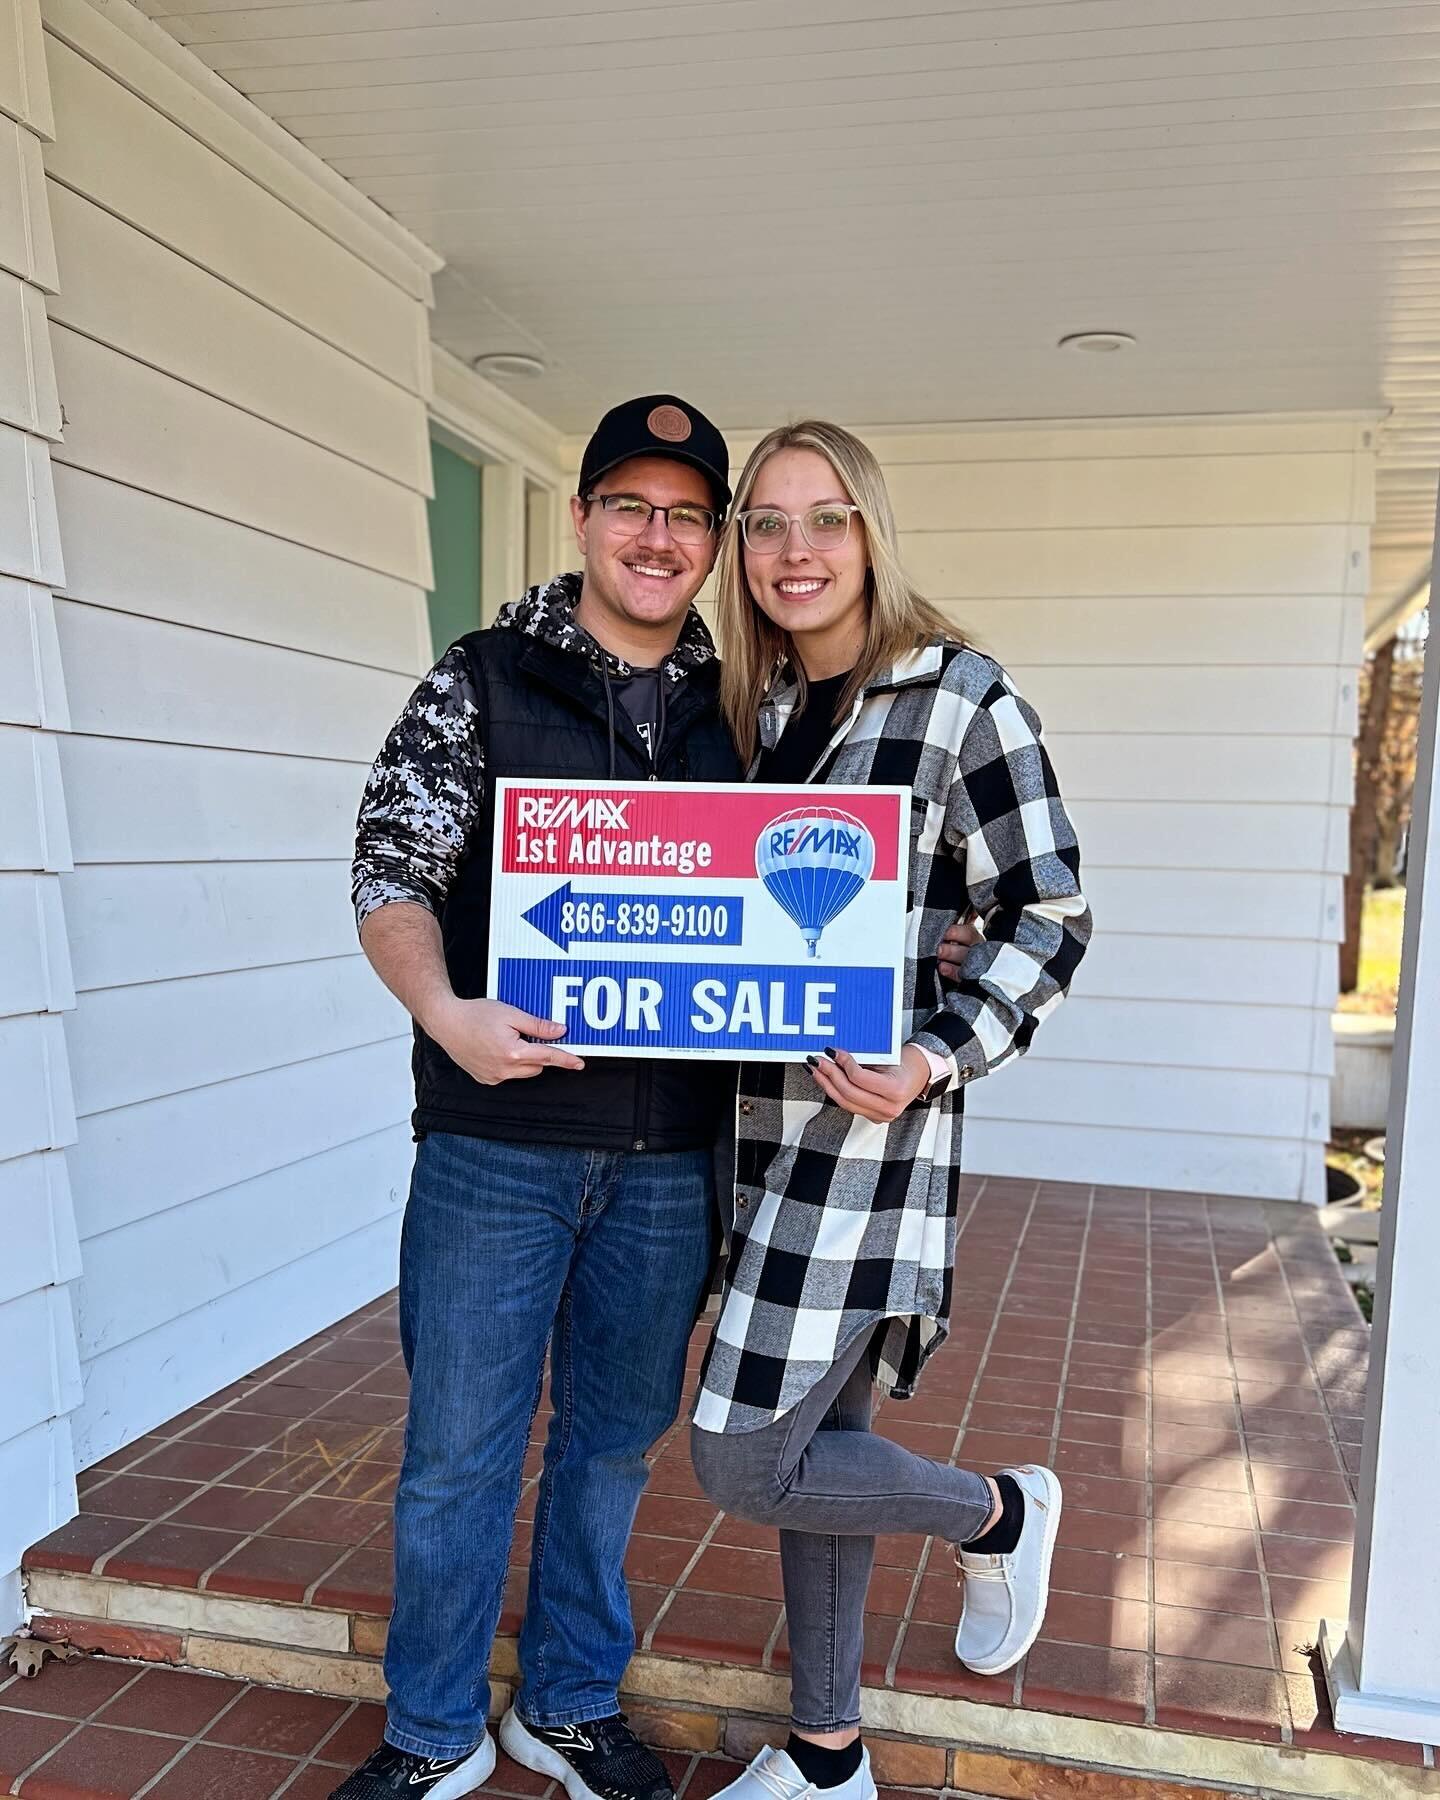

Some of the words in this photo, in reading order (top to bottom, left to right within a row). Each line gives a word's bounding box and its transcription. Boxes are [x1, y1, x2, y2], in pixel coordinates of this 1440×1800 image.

[518, 796, 631, 829] RE/MAX
[516, 832, 557, 864] 1st
[568, 833, 712, 874] Advantage
[770, 825, 863, 861] RE/MAX
[561, 901, 729, 938] 866-839-9100
[551, 976, 663, 1032] FOR
[690, 979, 836, 1036] SALE
